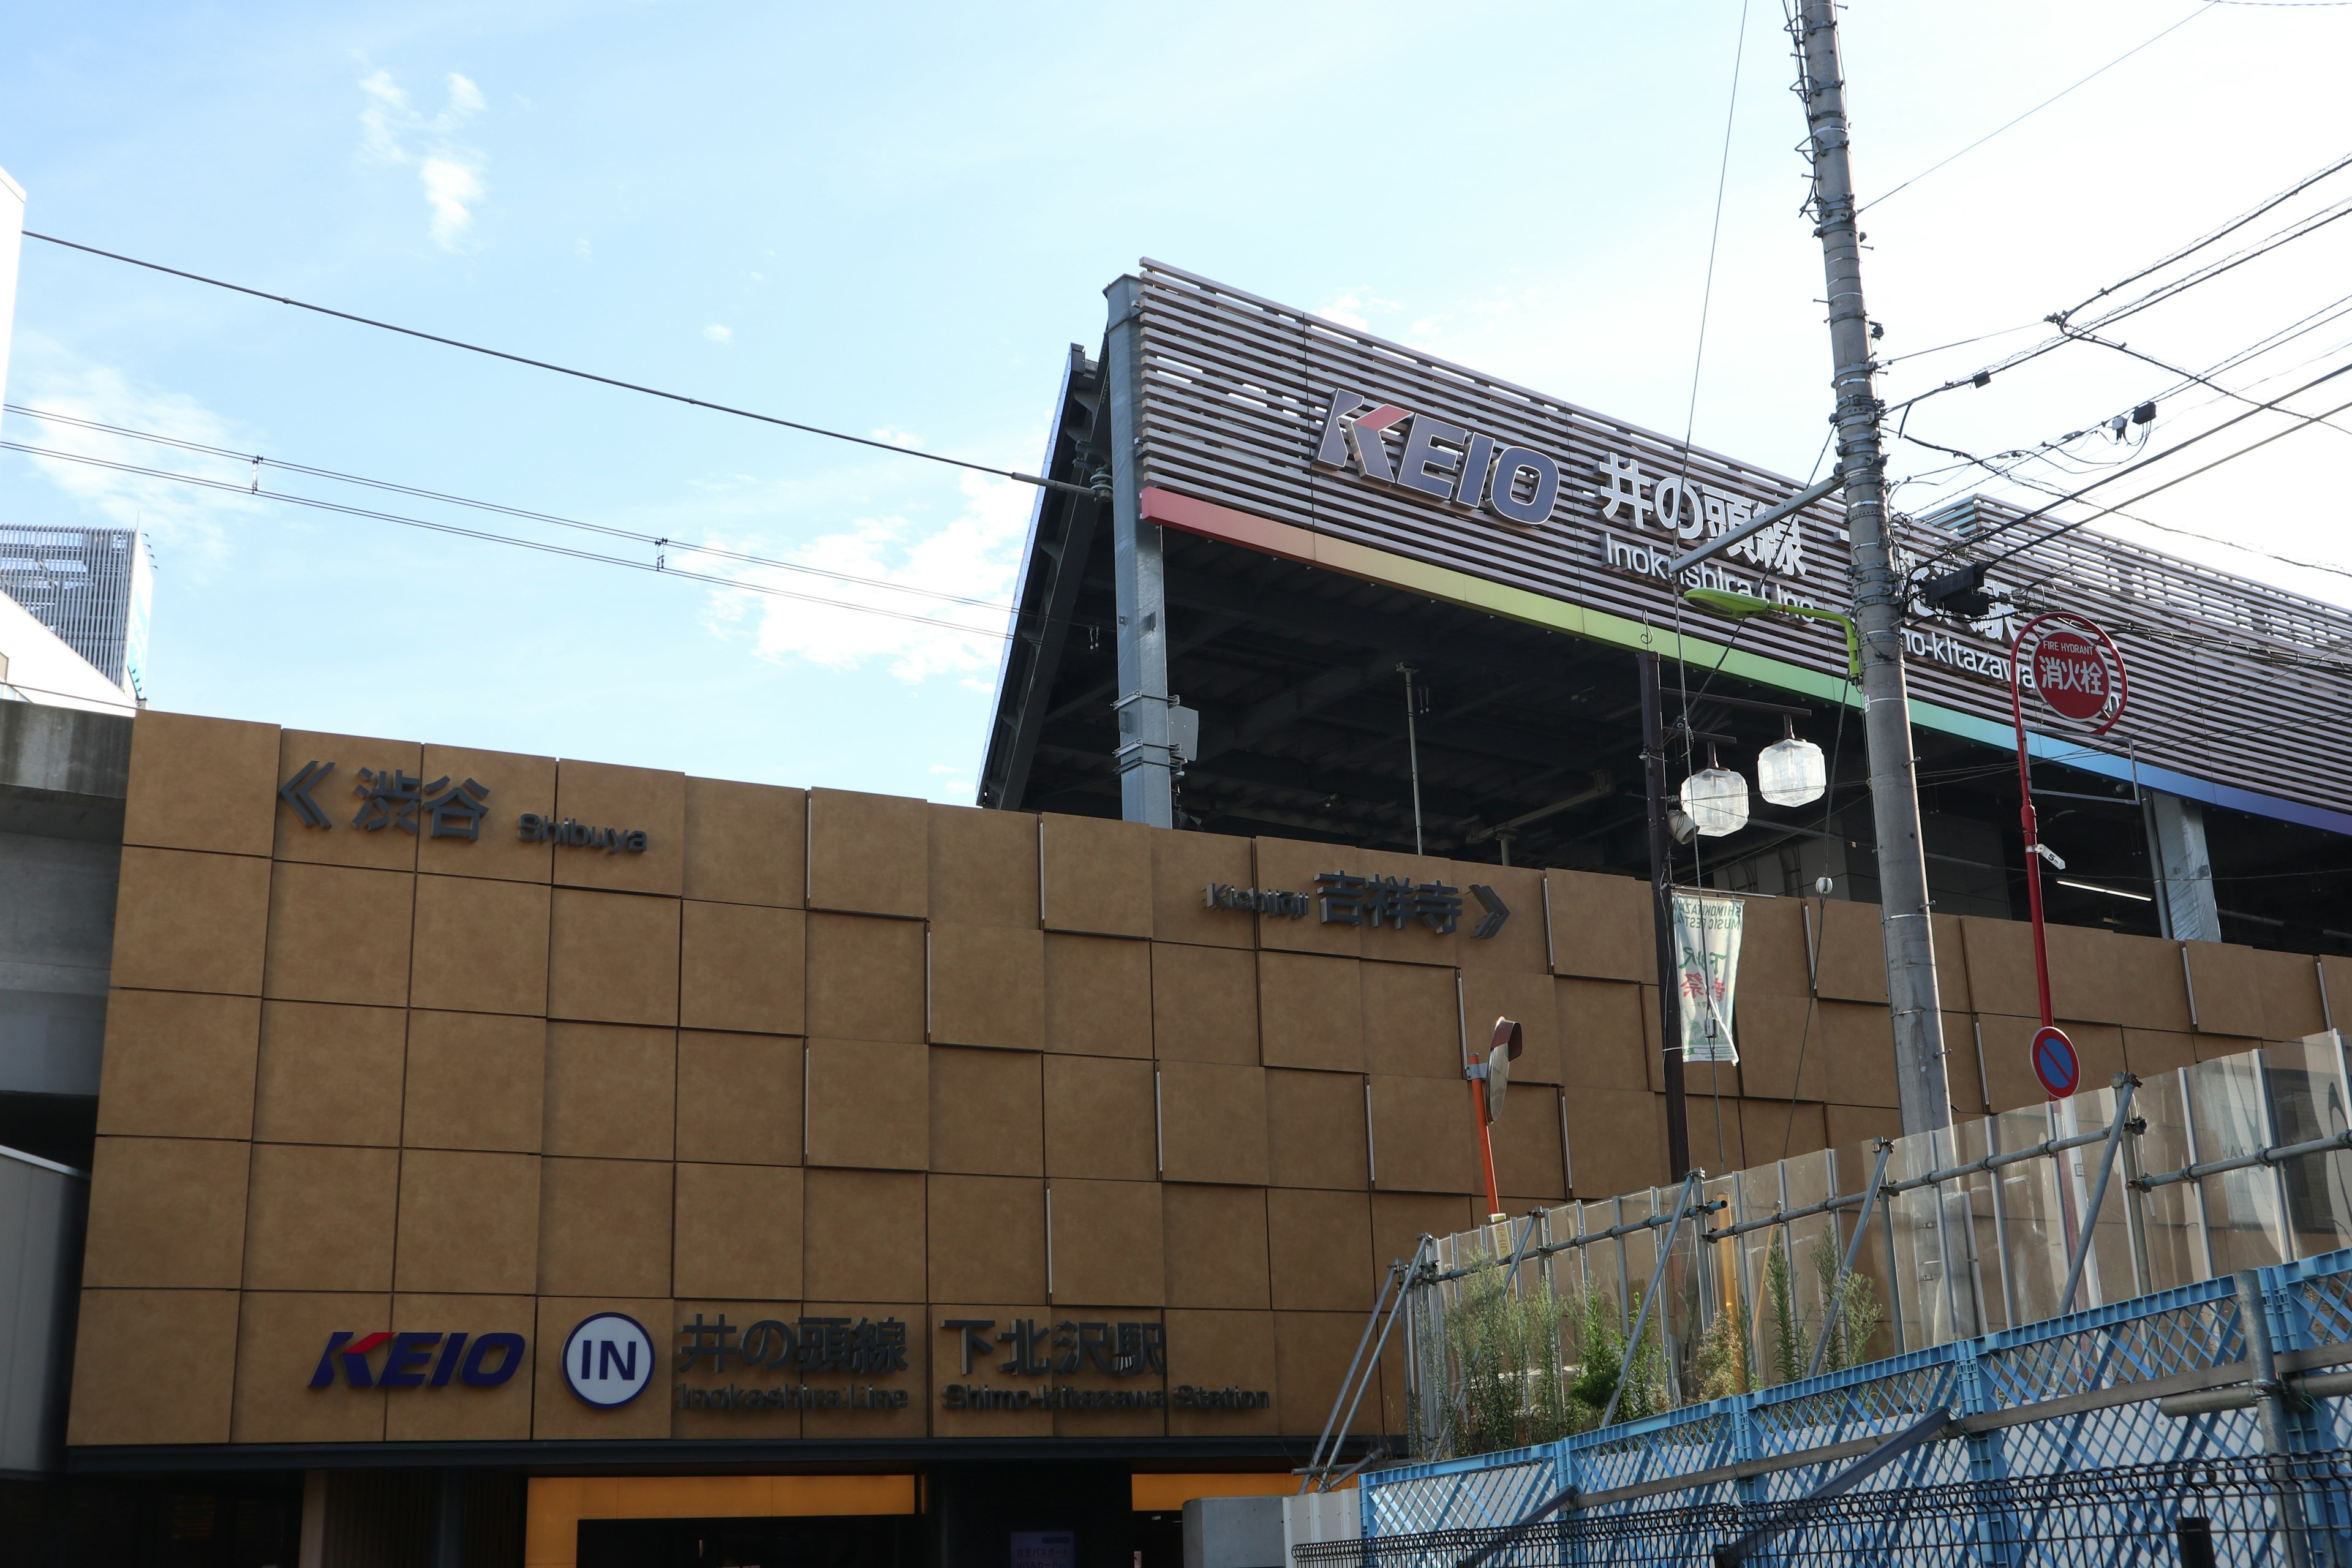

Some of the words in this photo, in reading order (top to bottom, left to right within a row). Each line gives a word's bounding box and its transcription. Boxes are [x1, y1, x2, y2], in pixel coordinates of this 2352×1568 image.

[1312, 388, 1560, 526] KEIO
[1595, 451, 1807, 577] 井の頭線
[2038, 655, 2105, 696] 消火栓
[2043, 640, 2059, 651] FIRE
[2061, 643, 2094, 655] HYDRANT
[350, 767, 490, 843] 渋谷
[517, 813, 647, 855] Shibuya
[1313, 870, 1463, 934] 吉祥寺
[307, 1331, 526, 1388] KEIO
[581, 1340, 637, 1381] IN
[677, 1313, 909, 1374] 井の頭線
[940, 1319, 1164, 1376] 下北沢駅
[676, 1382, 842, 1409] Inokashira
[848, 1383, 909, 1409] Line
[1172, 1385, 1270, 1410] Station
